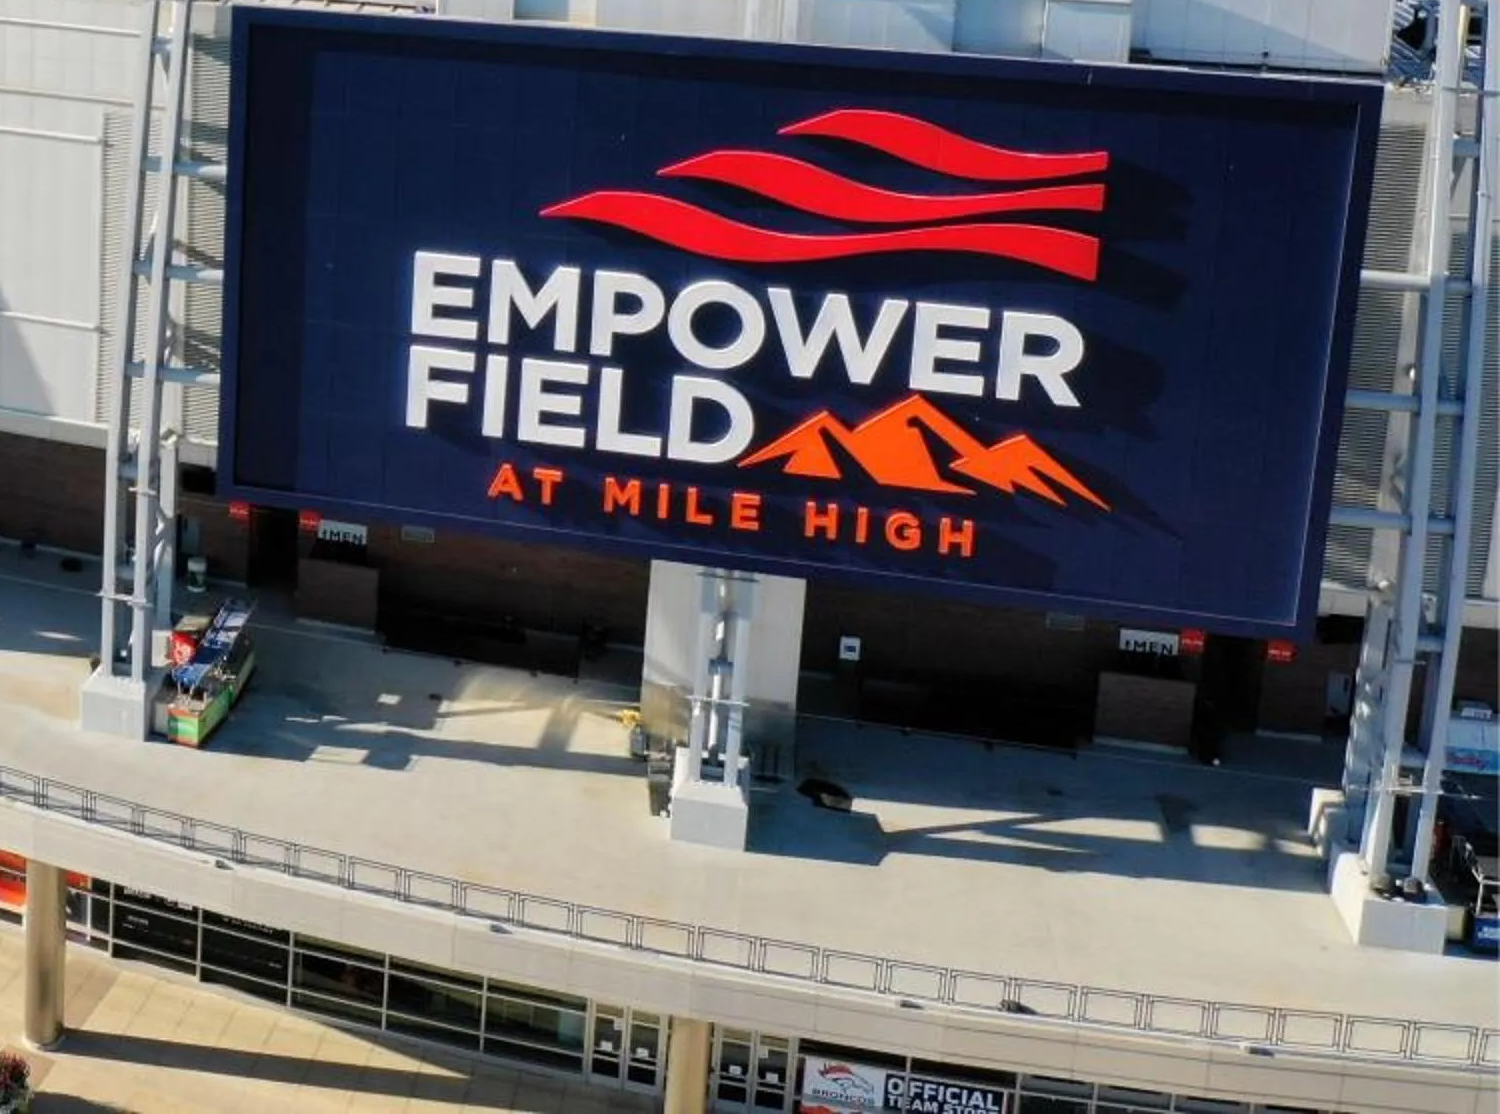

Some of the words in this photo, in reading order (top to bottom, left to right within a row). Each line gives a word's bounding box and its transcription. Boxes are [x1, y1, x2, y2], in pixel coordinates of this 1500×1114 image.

[411, 250, 1084, 407] EMPOWER
[406, 344, 754, 463] FIELD
[488, 463, 563, 505] AT
[603, 477, 761, 531] MILE
[804, 503, 975, 558] HIGH
[1133, 639, 1174, 655] MEN
[887, 1077, 1000, 1111] OFFICIAL
[887, 1095, 940, 1114] TEAM
